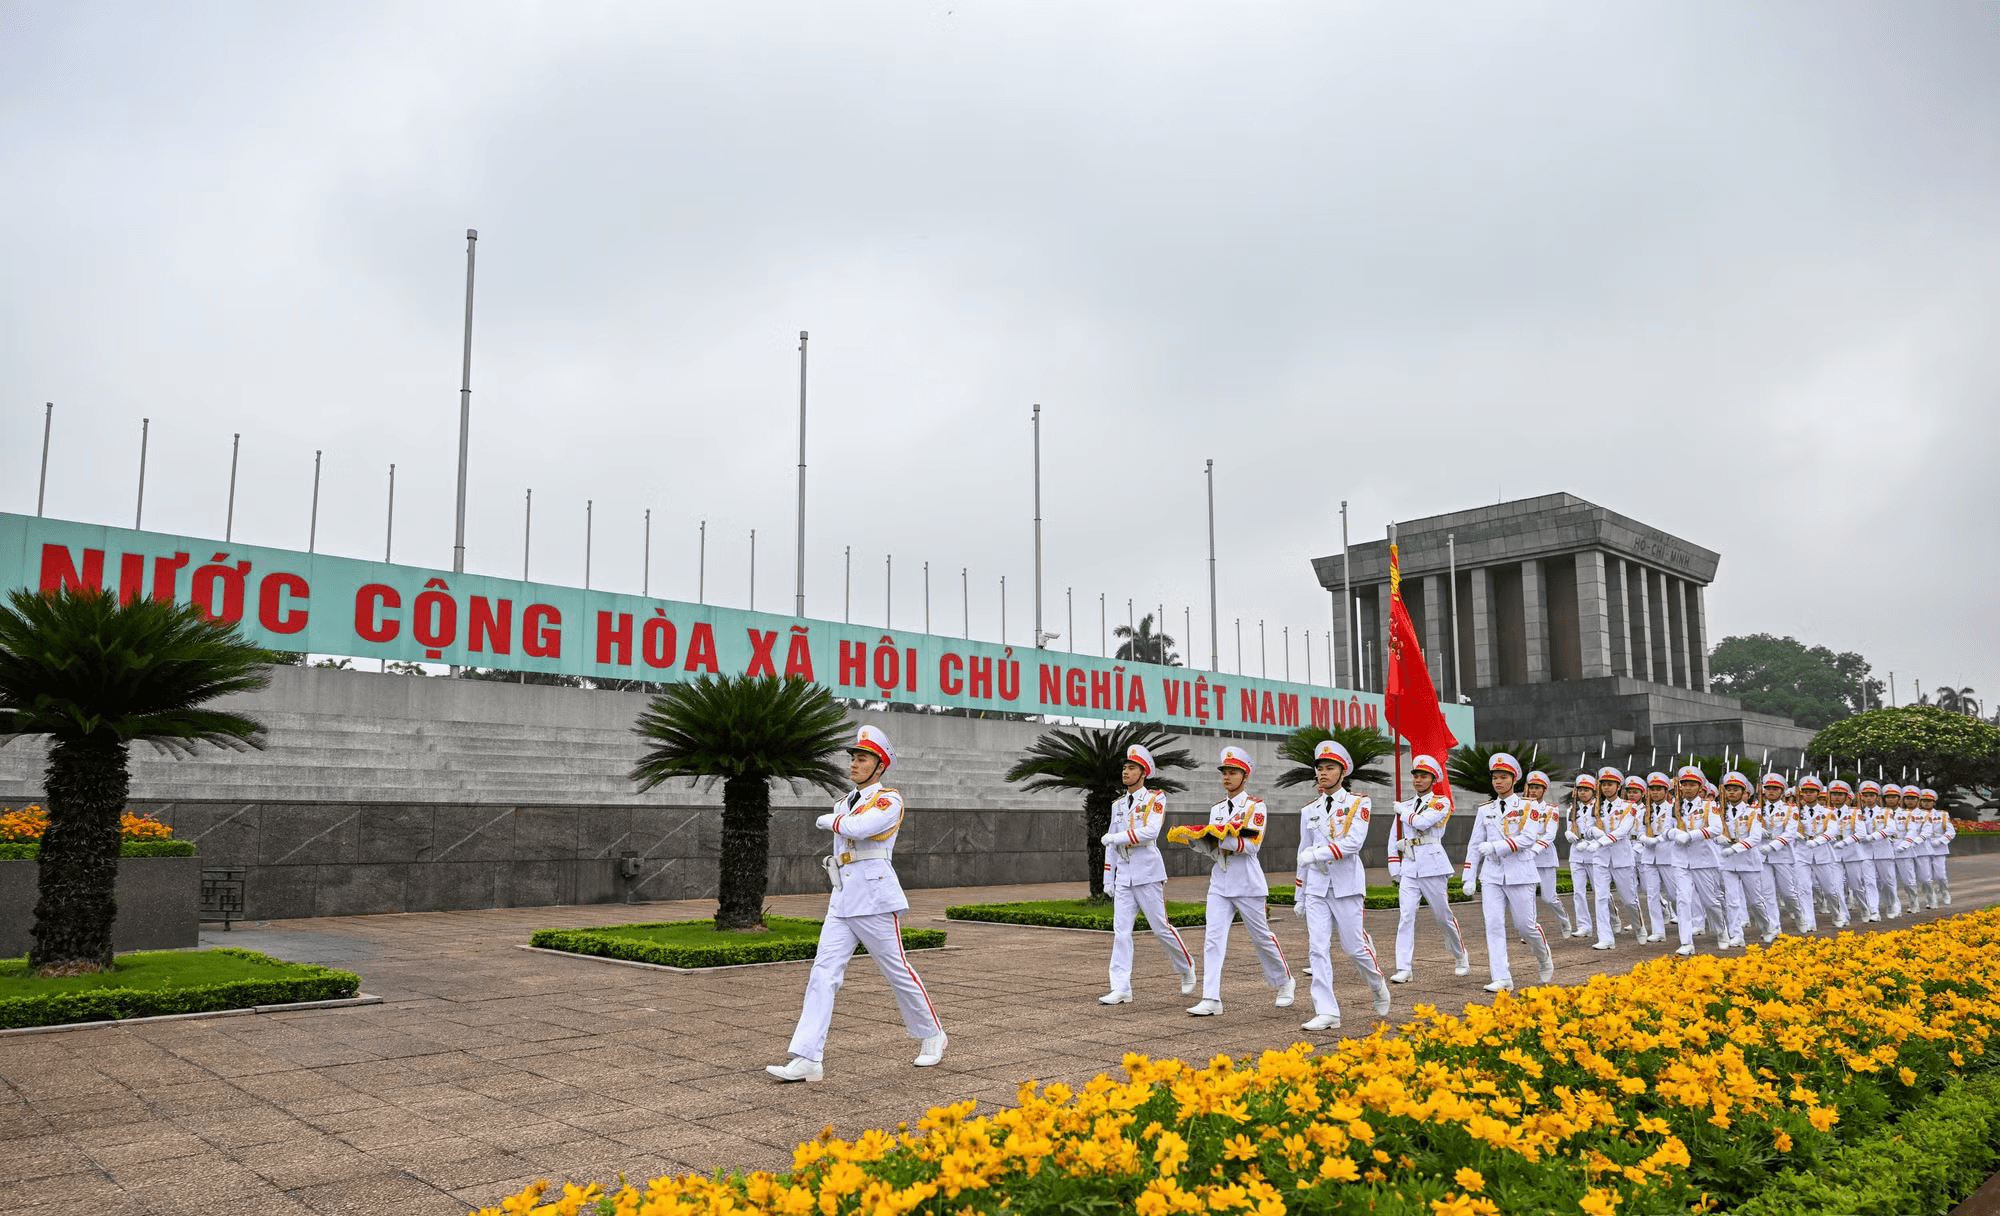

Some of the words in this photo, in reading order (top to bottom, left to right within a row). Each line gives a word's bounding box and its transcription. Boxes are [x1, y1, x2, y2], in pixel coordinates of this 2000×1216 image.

[354, 577, 562, 659] CỘNG
[595, 607, 719, 674] HÒA
[745, 625, 815, 683] XÃ
[839, 635, 917, 699] HỘI
[939, 647, 1020, 701] CHỦ
[1039, 664, 1147, 713] NGHĨA
[1162, 675, 1227, 725] VIỆT
[1241, 688, 1299, 727] NAM
[1311, 695, 1377, 731] MUÔN
